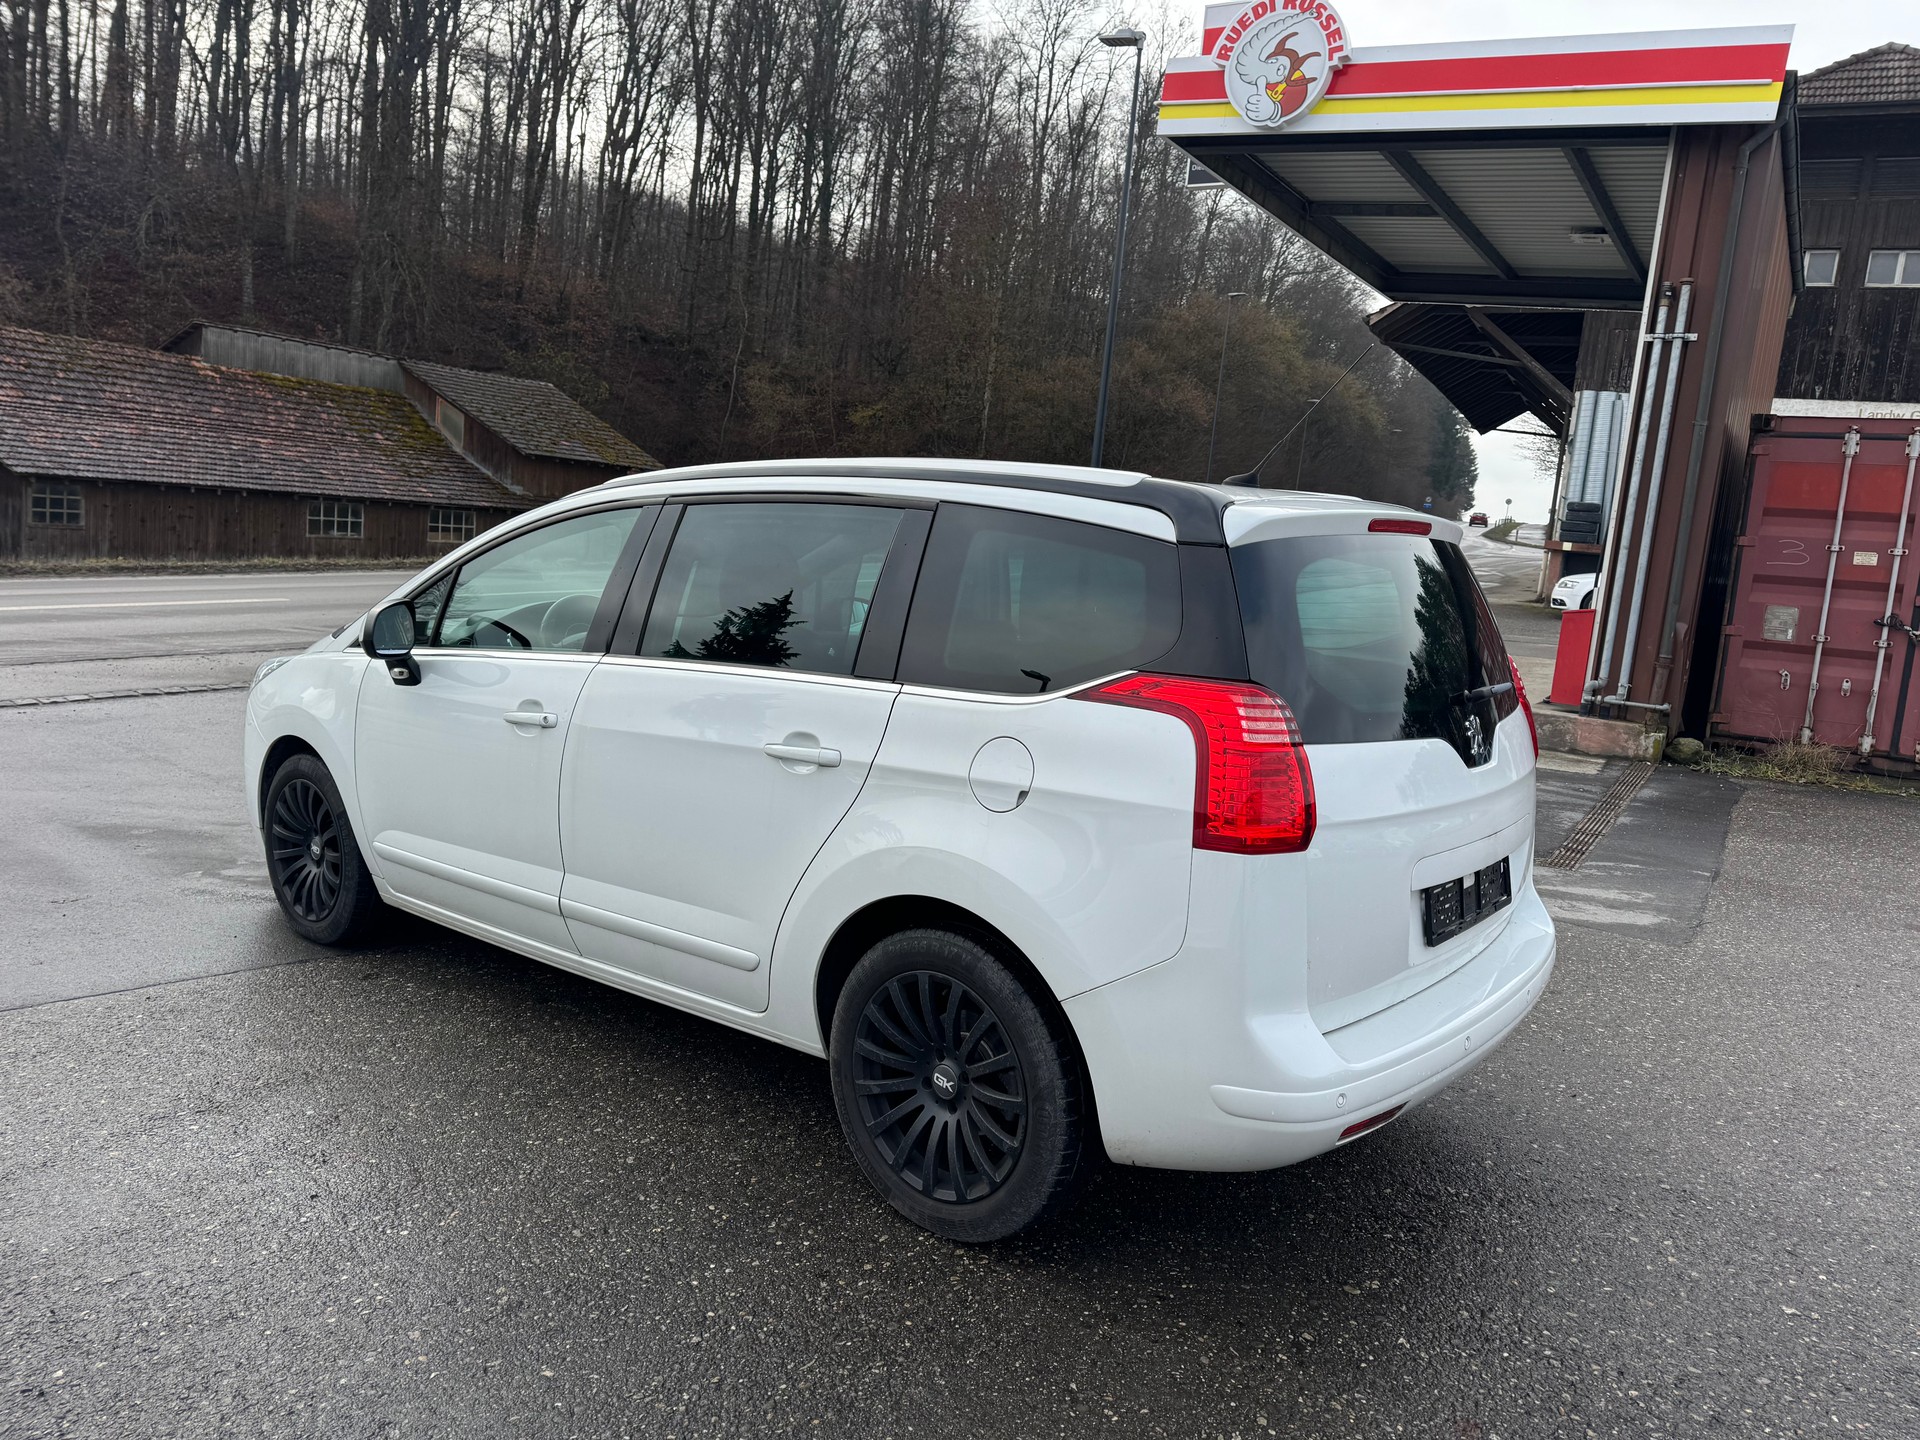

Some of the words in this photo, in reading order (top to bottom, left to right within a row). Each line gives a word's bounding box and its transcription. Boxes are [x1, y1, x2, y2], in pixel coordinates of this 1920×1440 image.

[1216, 0, 1277, 61] RUEDI
[1766, 539, 1810, 566] 3
[934, 1072, 955, 1093] GK
